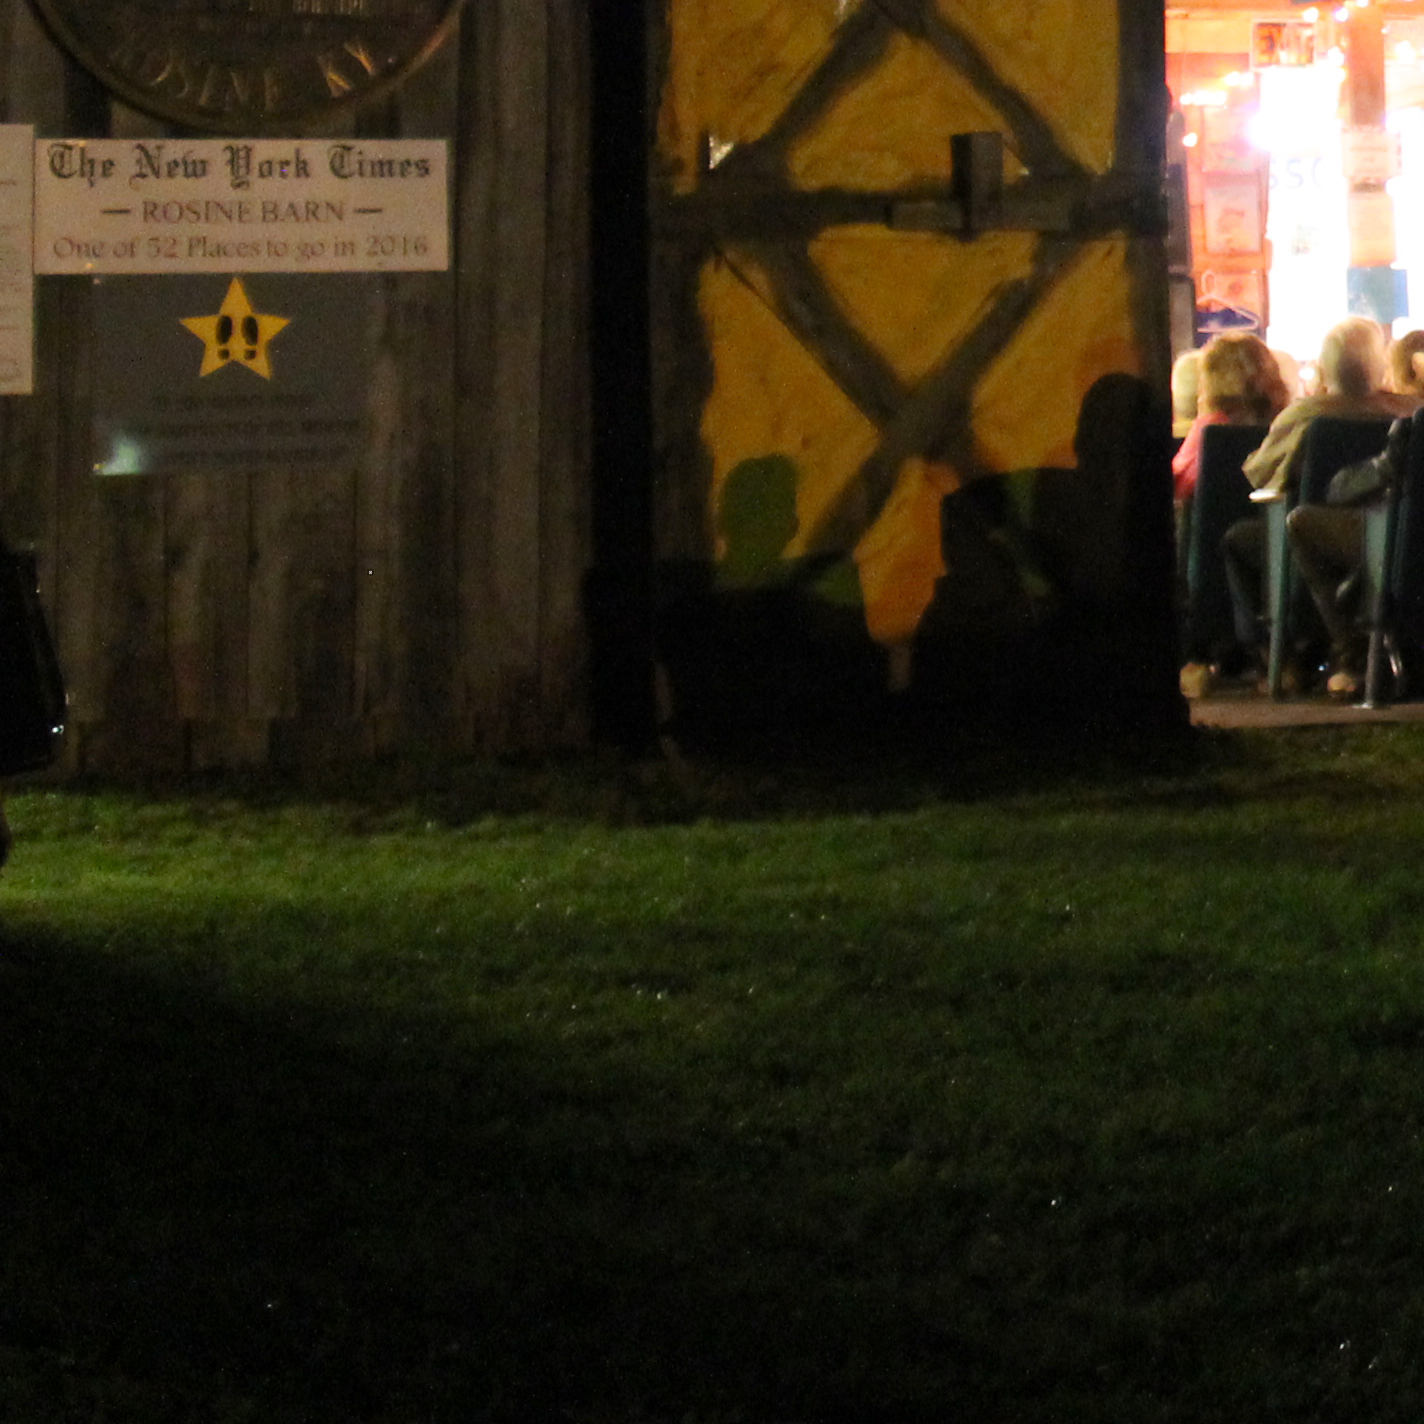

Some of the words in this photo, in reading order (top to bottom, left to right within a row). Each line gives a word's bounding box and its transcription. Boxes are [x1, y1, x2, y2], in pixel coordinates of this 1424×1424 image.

[48, 143, 115, 188] The
[129, 143, 207, 191] New
[223, 145, 310, 190] York
[328, 144, 430, 179] Times
[142, 200, 252, 224] ROSINE
[261, 200, 346, 223] BARN
[53, 237, 103, 259] One
[113, 235, 140, 258] of
[149, 236, 178, 258] 52
[187, 235, 260, 258] Places
[267, 239, 289, 258] to
[298, 240, 326, 261] go
[334, 236, 355, 258] in
[364, 234, 428, 257] 2016
